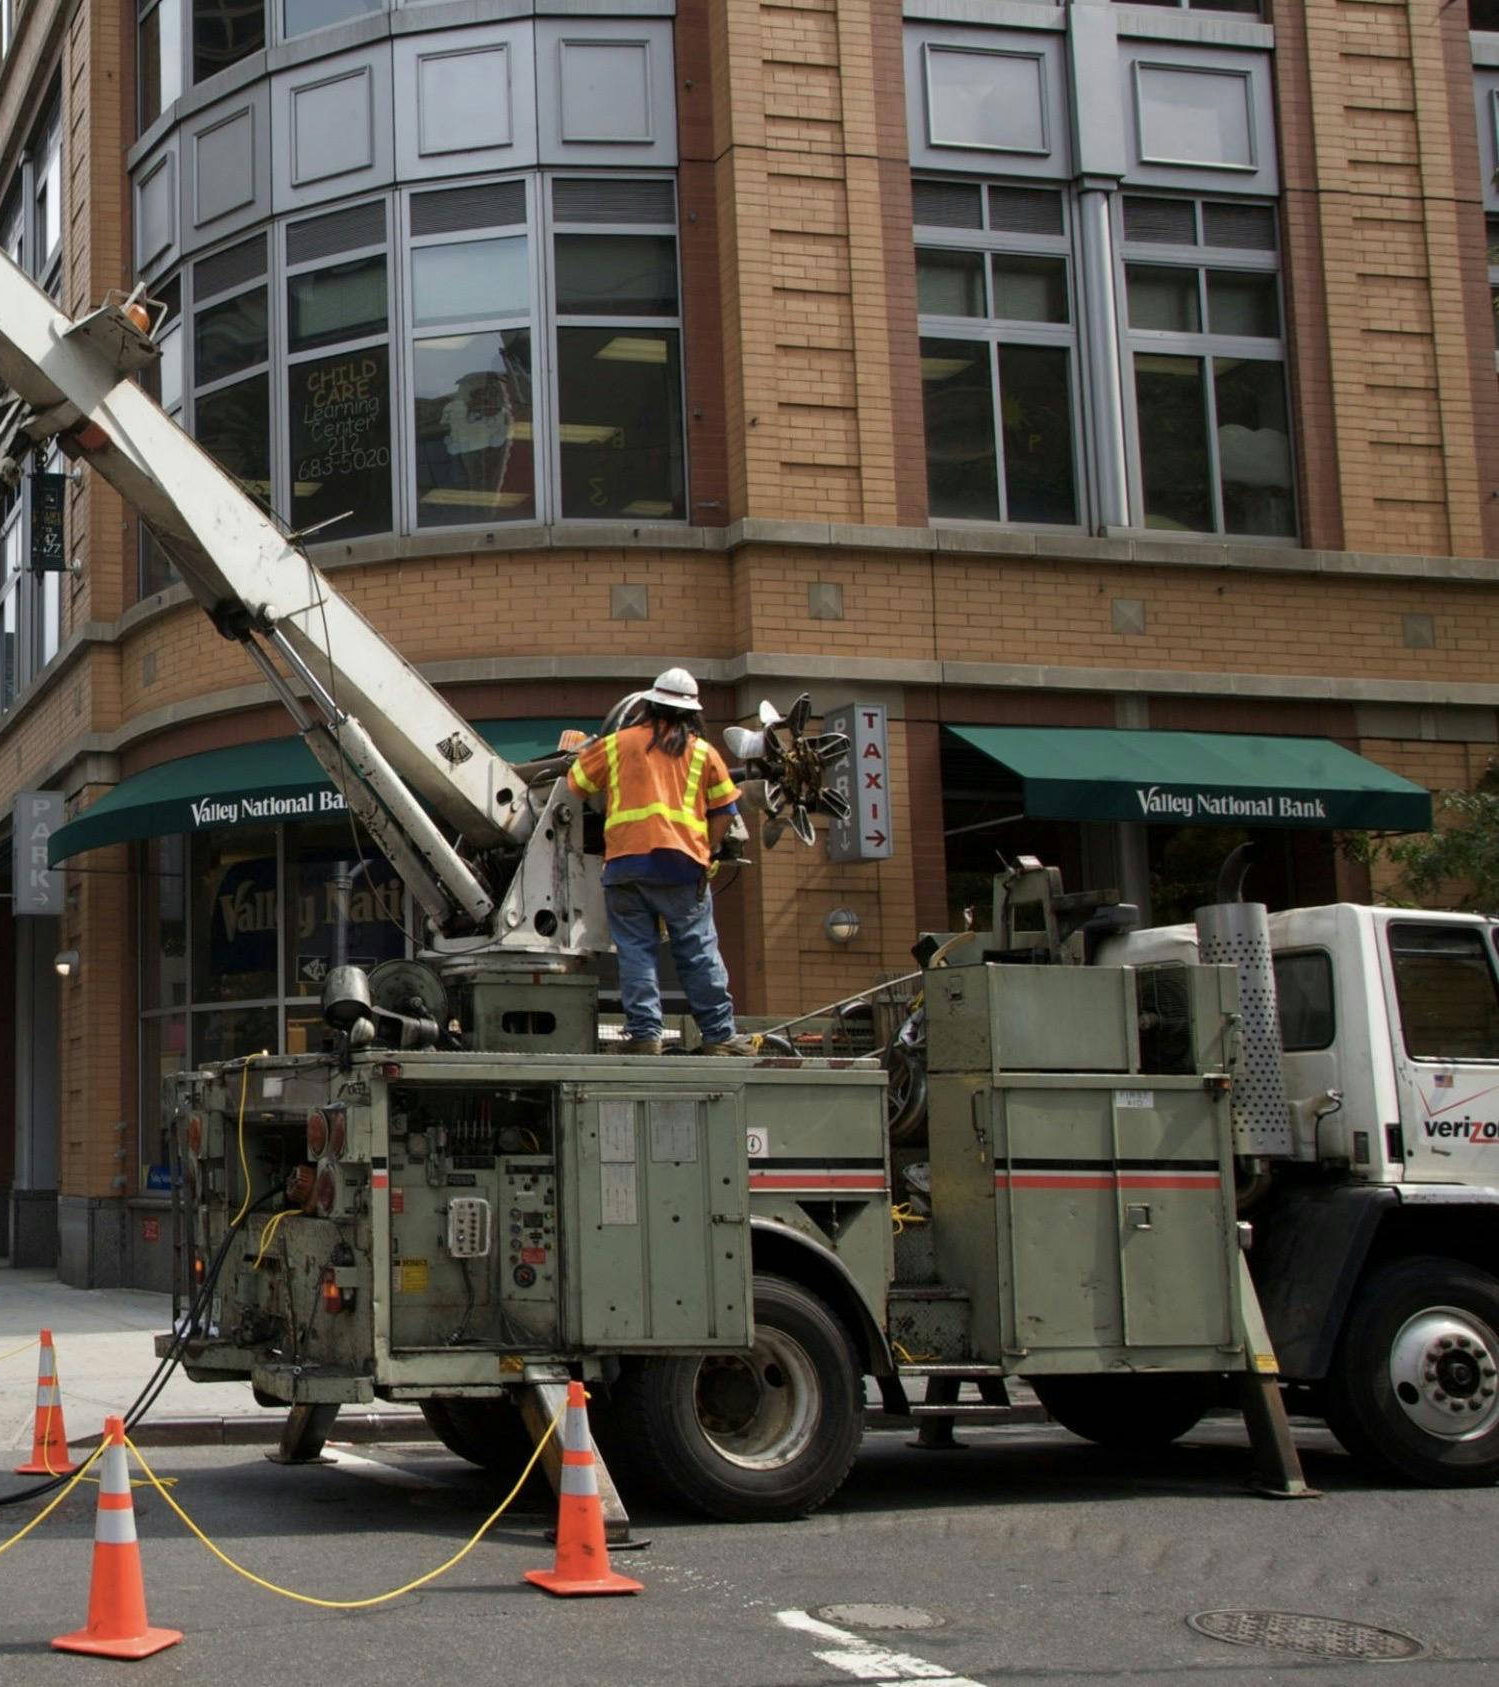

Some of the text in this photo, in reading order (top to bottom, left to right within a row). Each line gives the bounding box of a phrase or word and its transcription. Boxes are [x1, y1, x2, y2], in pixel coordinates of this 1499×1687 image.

[308, 361, 377, 391] CHILD
[314, 379, 370, 407] CARE
[303, 397, 380, 424] Learning
[311, 417, 376, 442] Center
[328, 433, 361, 456] 212
[298, 446, 390, 480] 683-5020
[862, 712, 883, 820] TAXI
[191, 790, 348, 827] Valley National Ba
[1137, 786, 1327, 818] Valley National Bank
[220, 880, 315, 944] Vally
[1424, 1116, 1499, 1144] verizo
